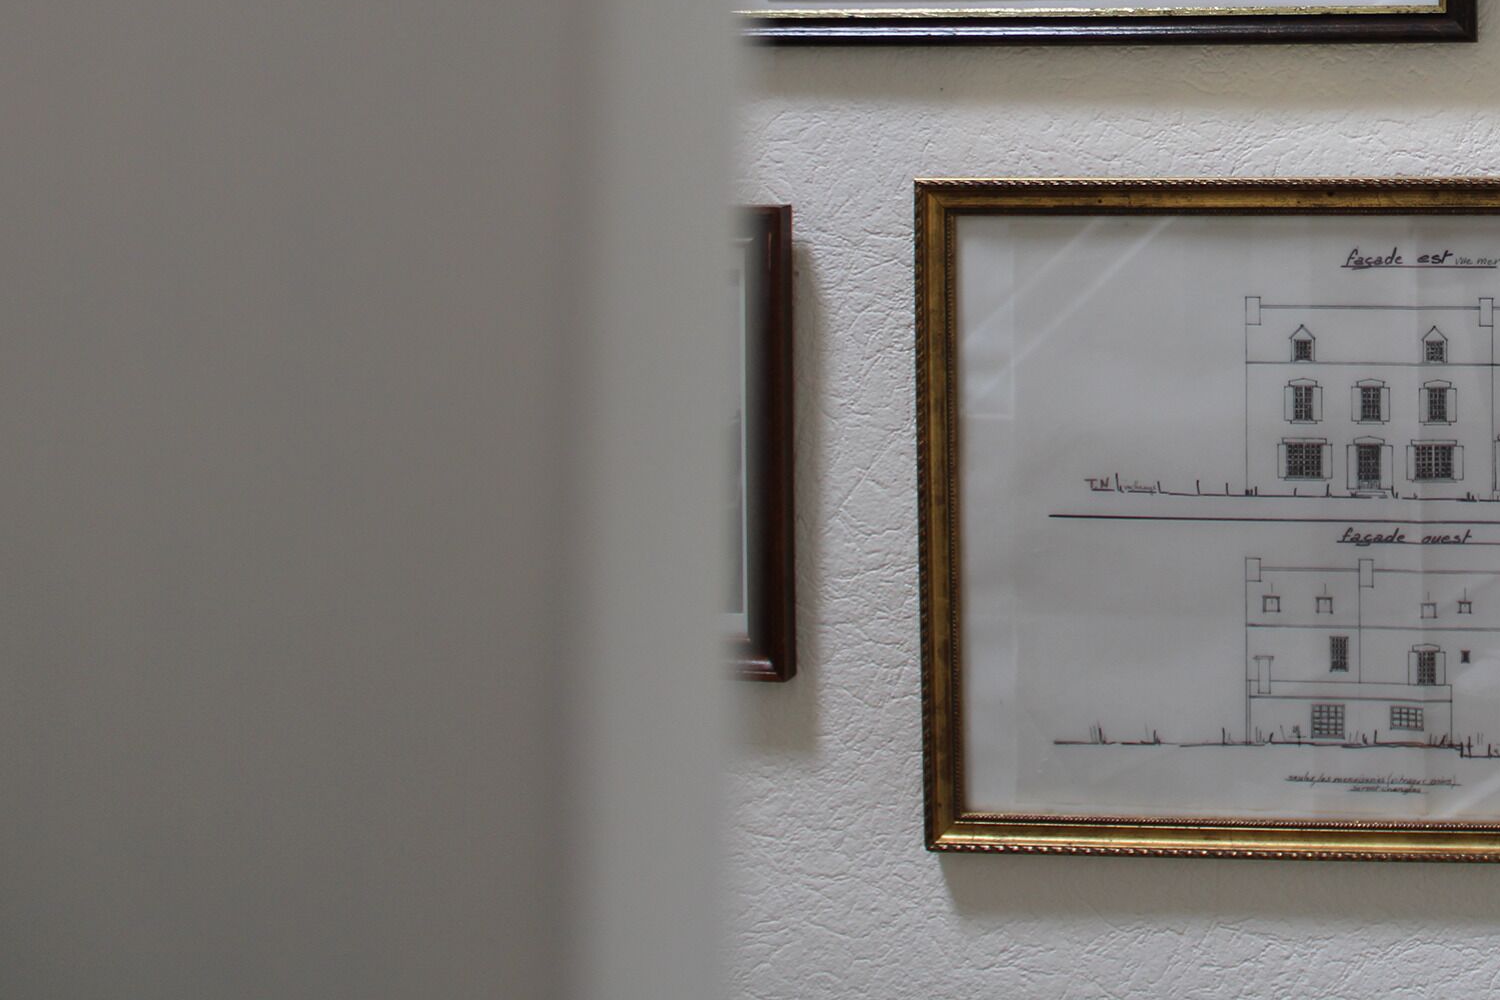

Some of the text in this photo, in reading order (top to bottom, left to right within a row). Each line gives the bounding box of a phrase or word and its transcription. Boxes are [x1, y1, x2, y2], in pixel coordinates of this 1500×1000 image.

[1346, 247, 1402, 270] façade
[1417, 250, 1453, 265] est
[1342, 527, 1472, 547] façade ouest
